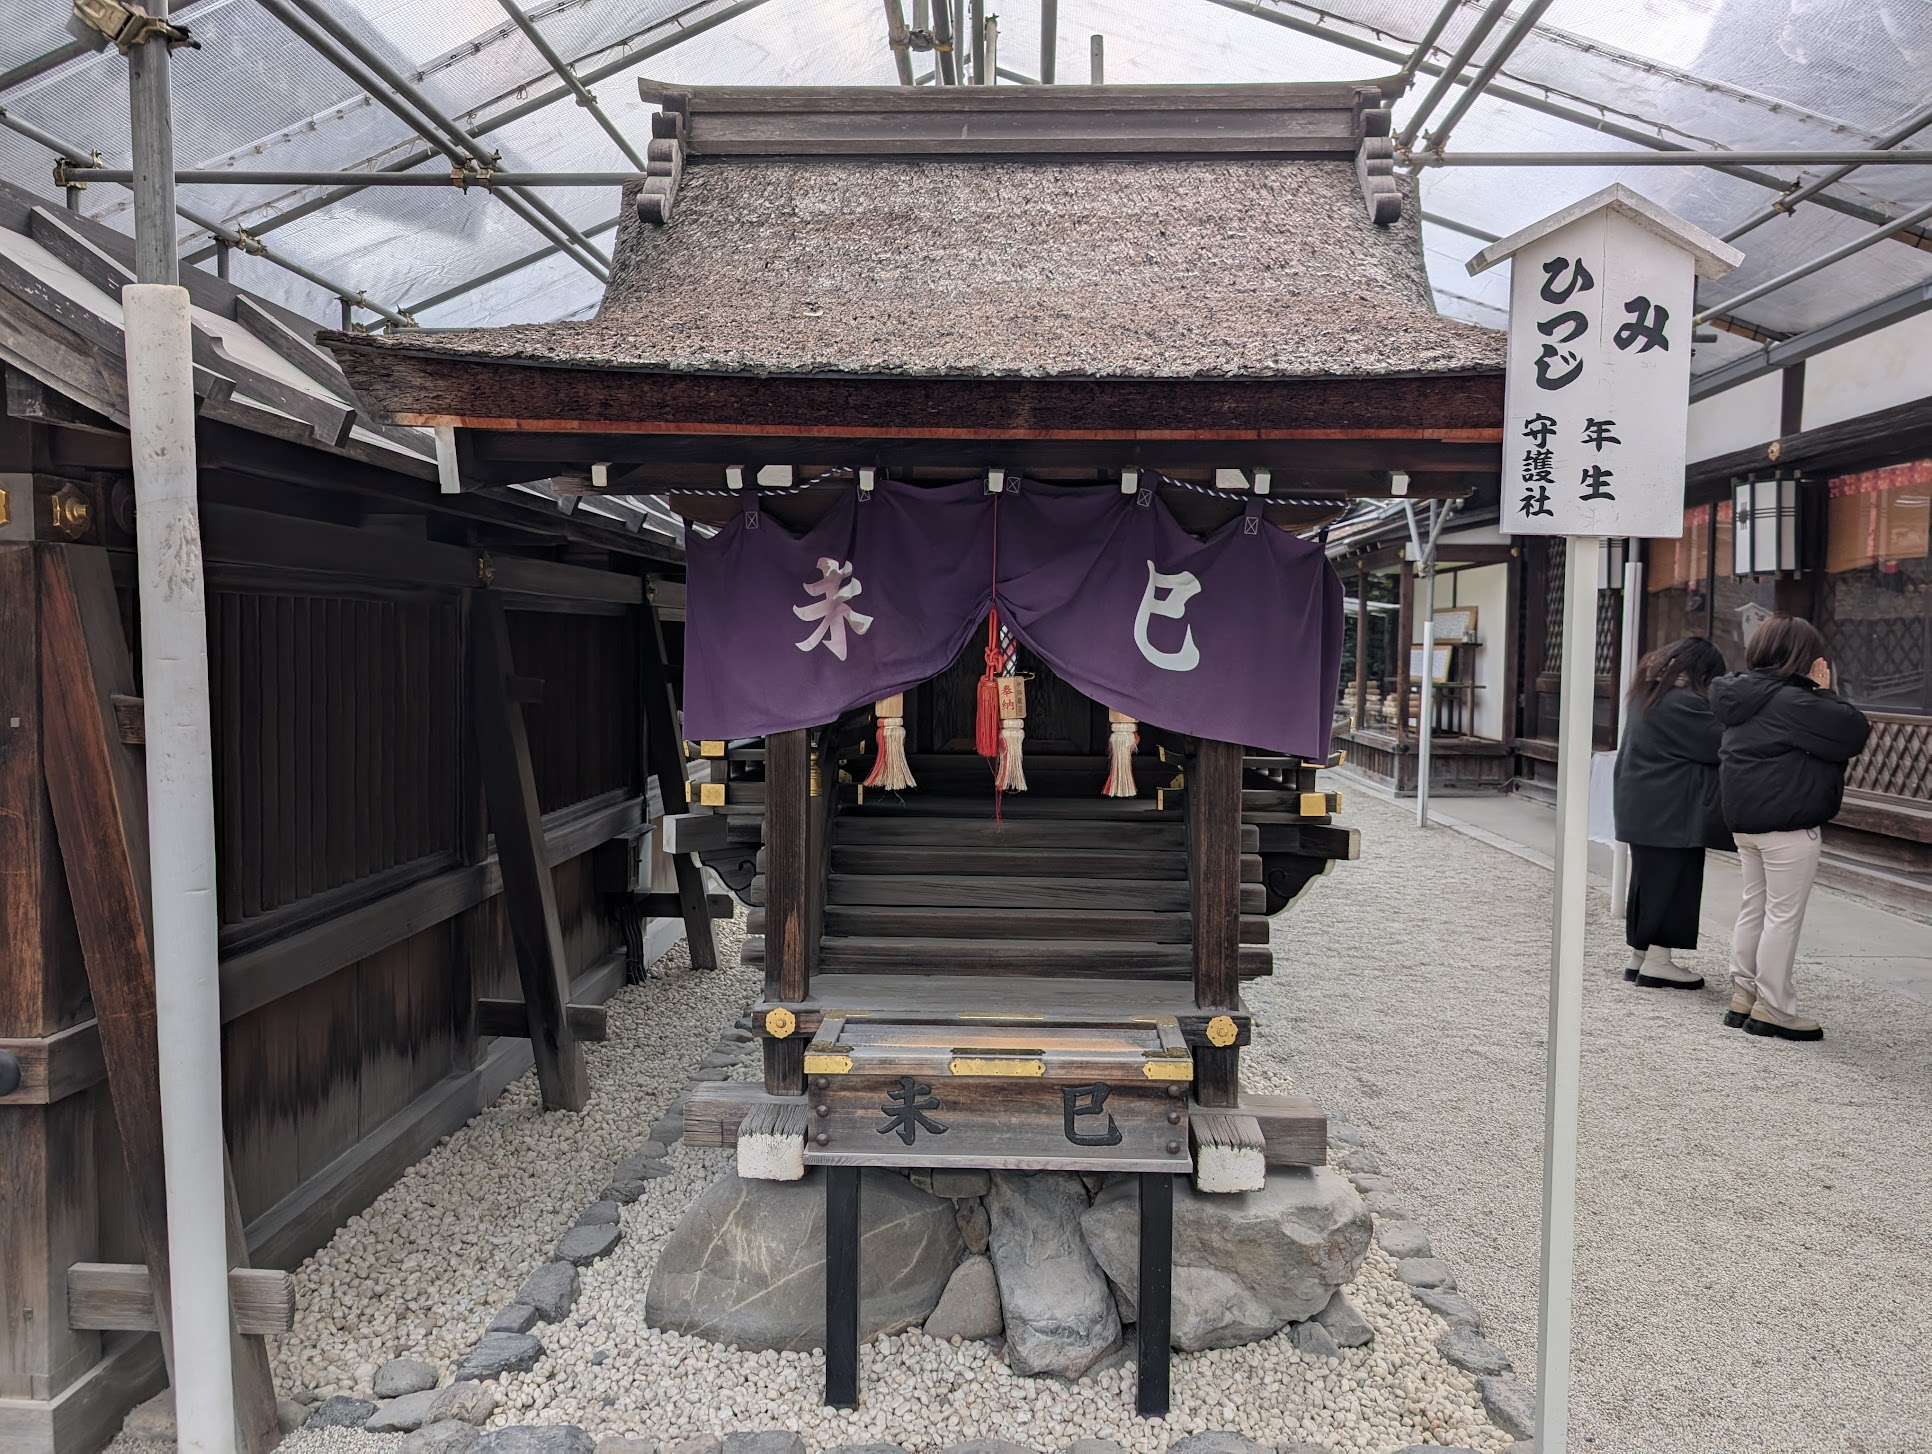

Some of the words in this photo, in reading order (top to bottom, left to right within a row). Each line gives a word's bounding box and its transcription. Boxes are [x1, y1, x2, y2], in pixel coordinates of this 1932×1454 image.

[1534, 256, 1594, 390] ひつじ
[1612, 296, 1669, 354] み
[1516, 413, 1557, 518] 守護社
[1578, 417, 1621, 501] 年生
[793, 557, 874, 661] 未
[1134, 560, 1201, 671] 巳
[1001, 684, 1014, 710] 奉納
[877, 1076, 949, 1146] 未
[1061, 1082, 1123, 1147] 巳
